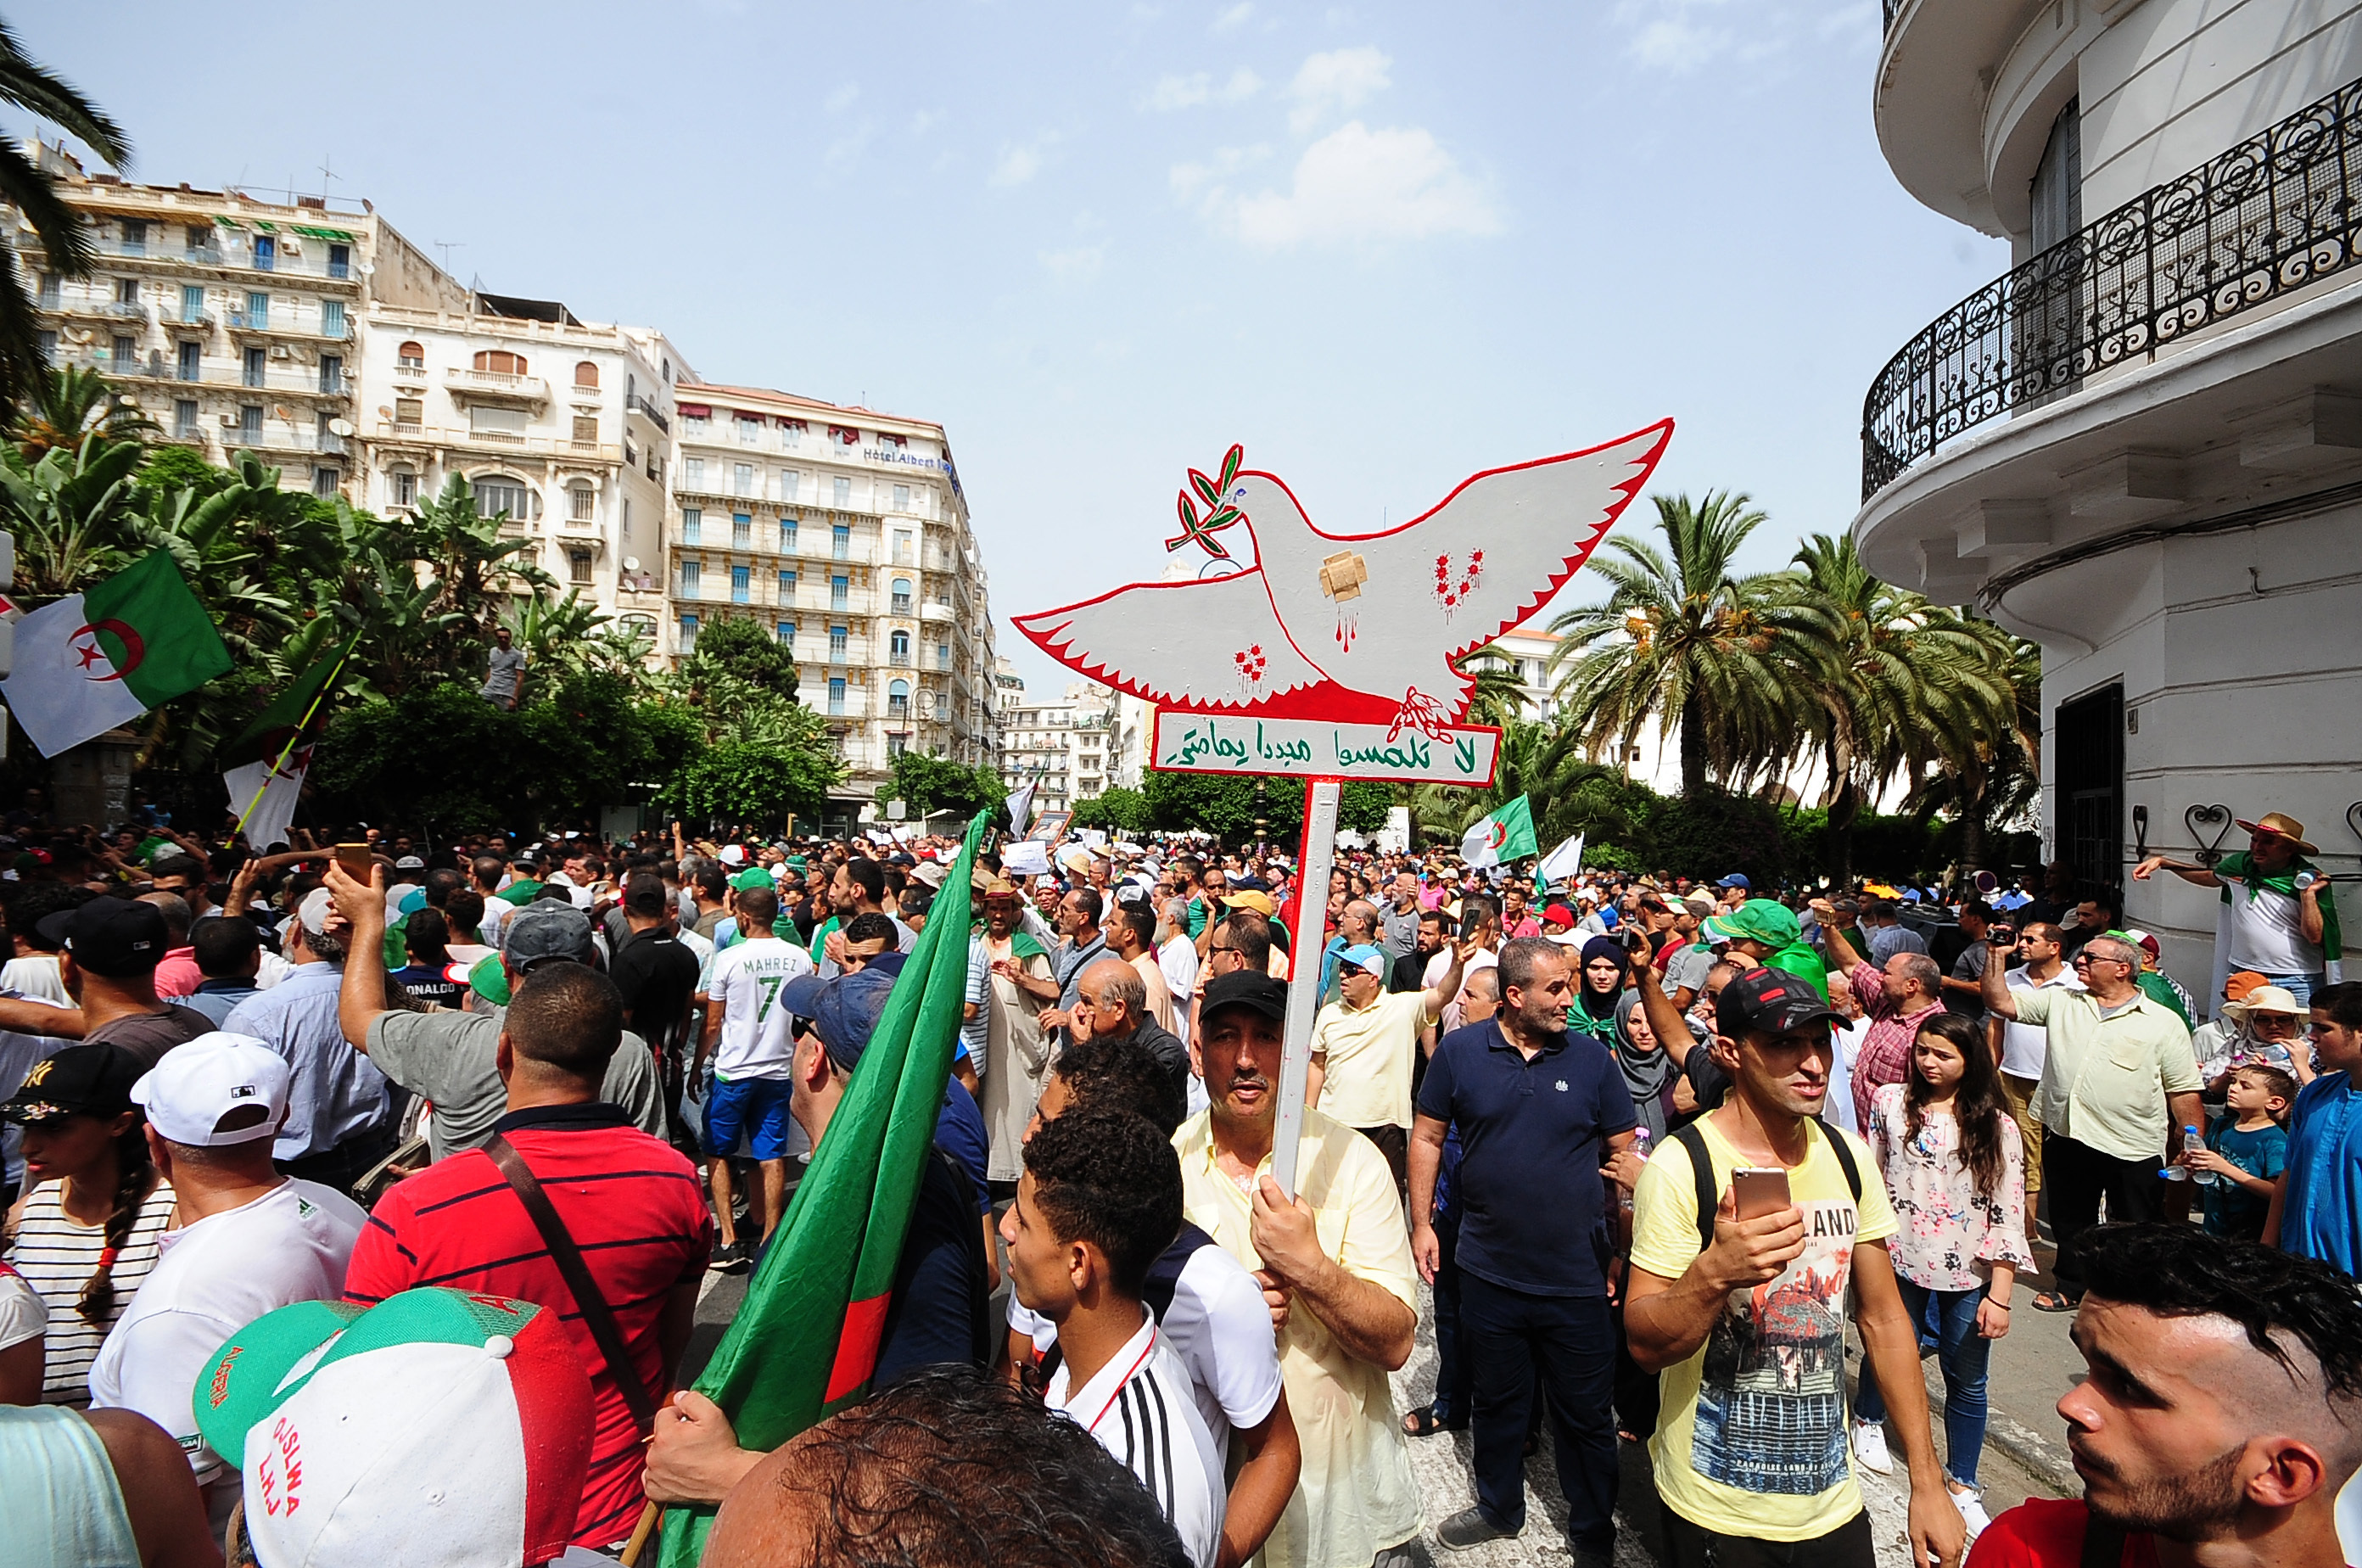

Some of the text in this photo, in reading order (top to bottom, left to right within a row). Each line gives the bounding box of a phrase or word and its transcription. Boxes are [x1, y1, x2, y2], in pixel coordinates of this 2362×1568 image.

[898, 453, 934, 469] Albert
[1454, 736, 1475, 774] لا
[743, 957, 798, 974] MAHREZ
[406, 983, 456, 995] ONALDO
[758, 976, 784, 1023] 7
[1803, 1208, 1855, 1237] AND
